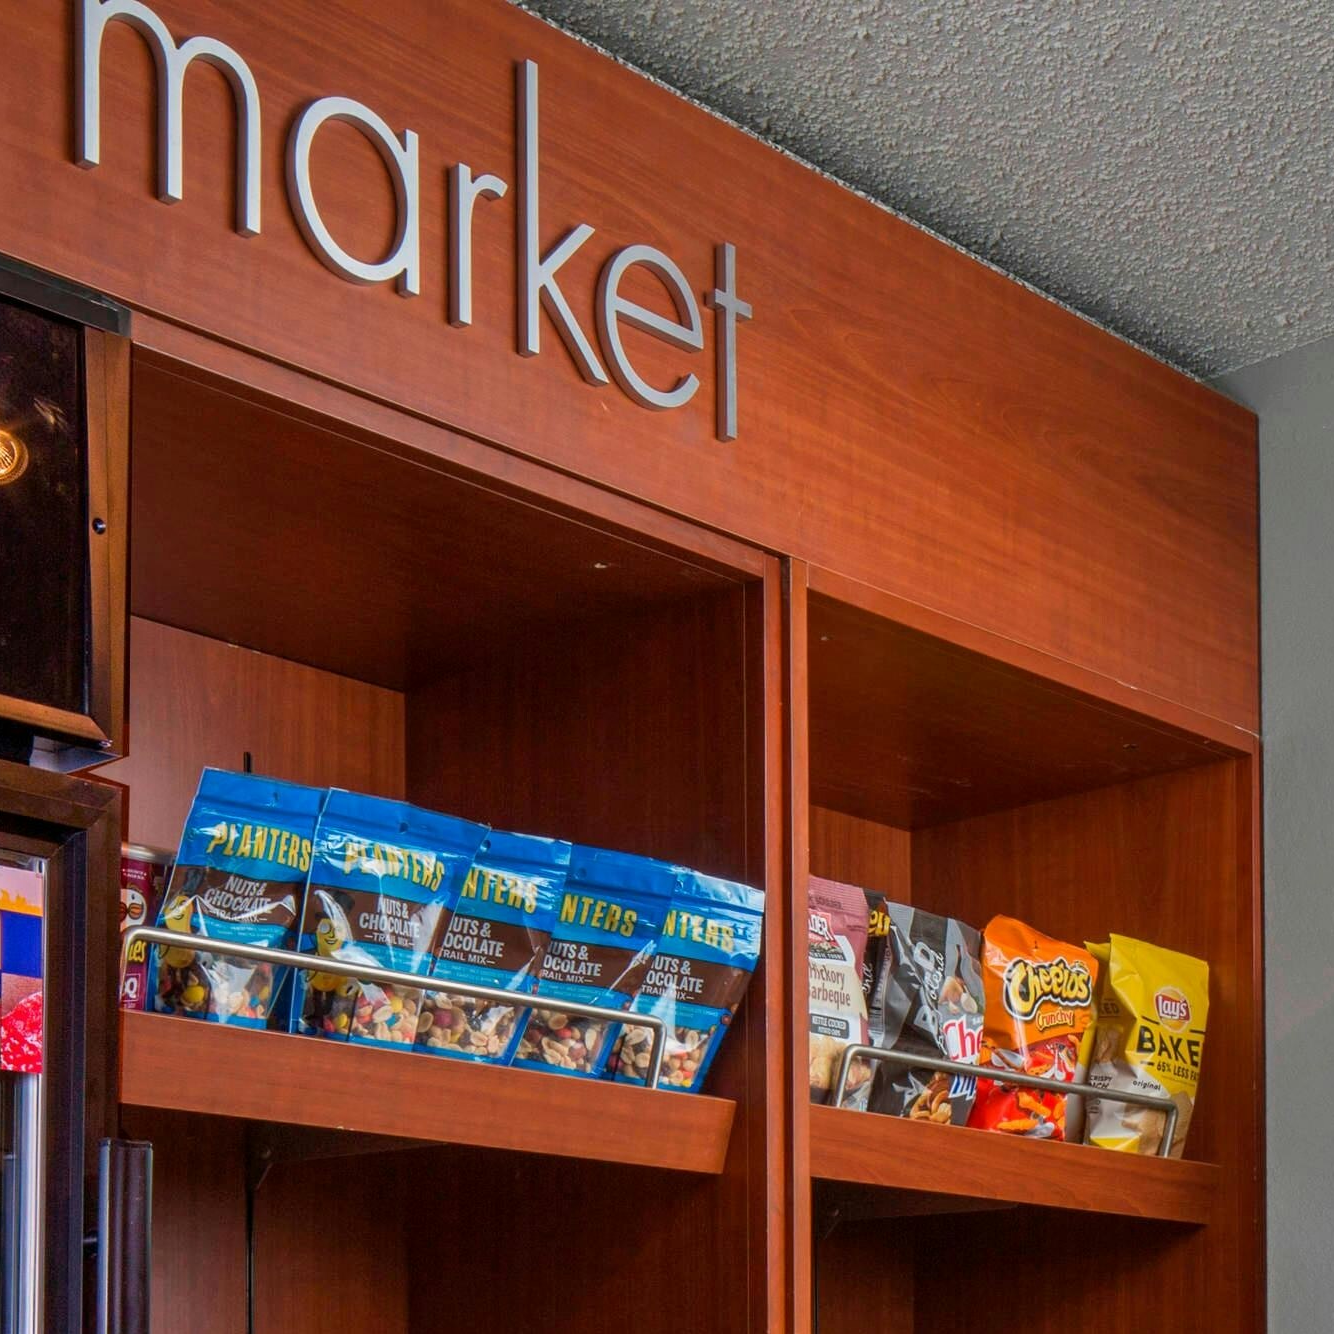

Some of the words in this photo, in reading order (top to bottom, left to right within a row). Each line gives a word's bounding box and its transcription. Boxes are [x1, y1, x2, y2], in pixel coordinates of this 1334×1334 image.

[82, 0, 753, 442] market
[206, 821, 313, 874] PLANTERS
[343, 838, 446, 892] PLANTERS
[225, 875, 258, 897] NUTS
[203, 887, 272, 917] CHOCOLATE
[376, 896, 402, 918] NUTS
[359, 910, 420, 939] CHOCOLATE
[810, 963, 846, 990] Hickory
[1006, 956, 1093, 1015] Cheetos
[810, 984, 851, 1010] arbeque
[1155, 992, 1190, 1022] Lay's
[1035, 1010, 1075, 1033] Crunchy
[1136, 1024, 1201, 1065] BAKE
[1172, 1063, 1191, 1077] LESS
[1133, 1079, 1161, 1092] original
